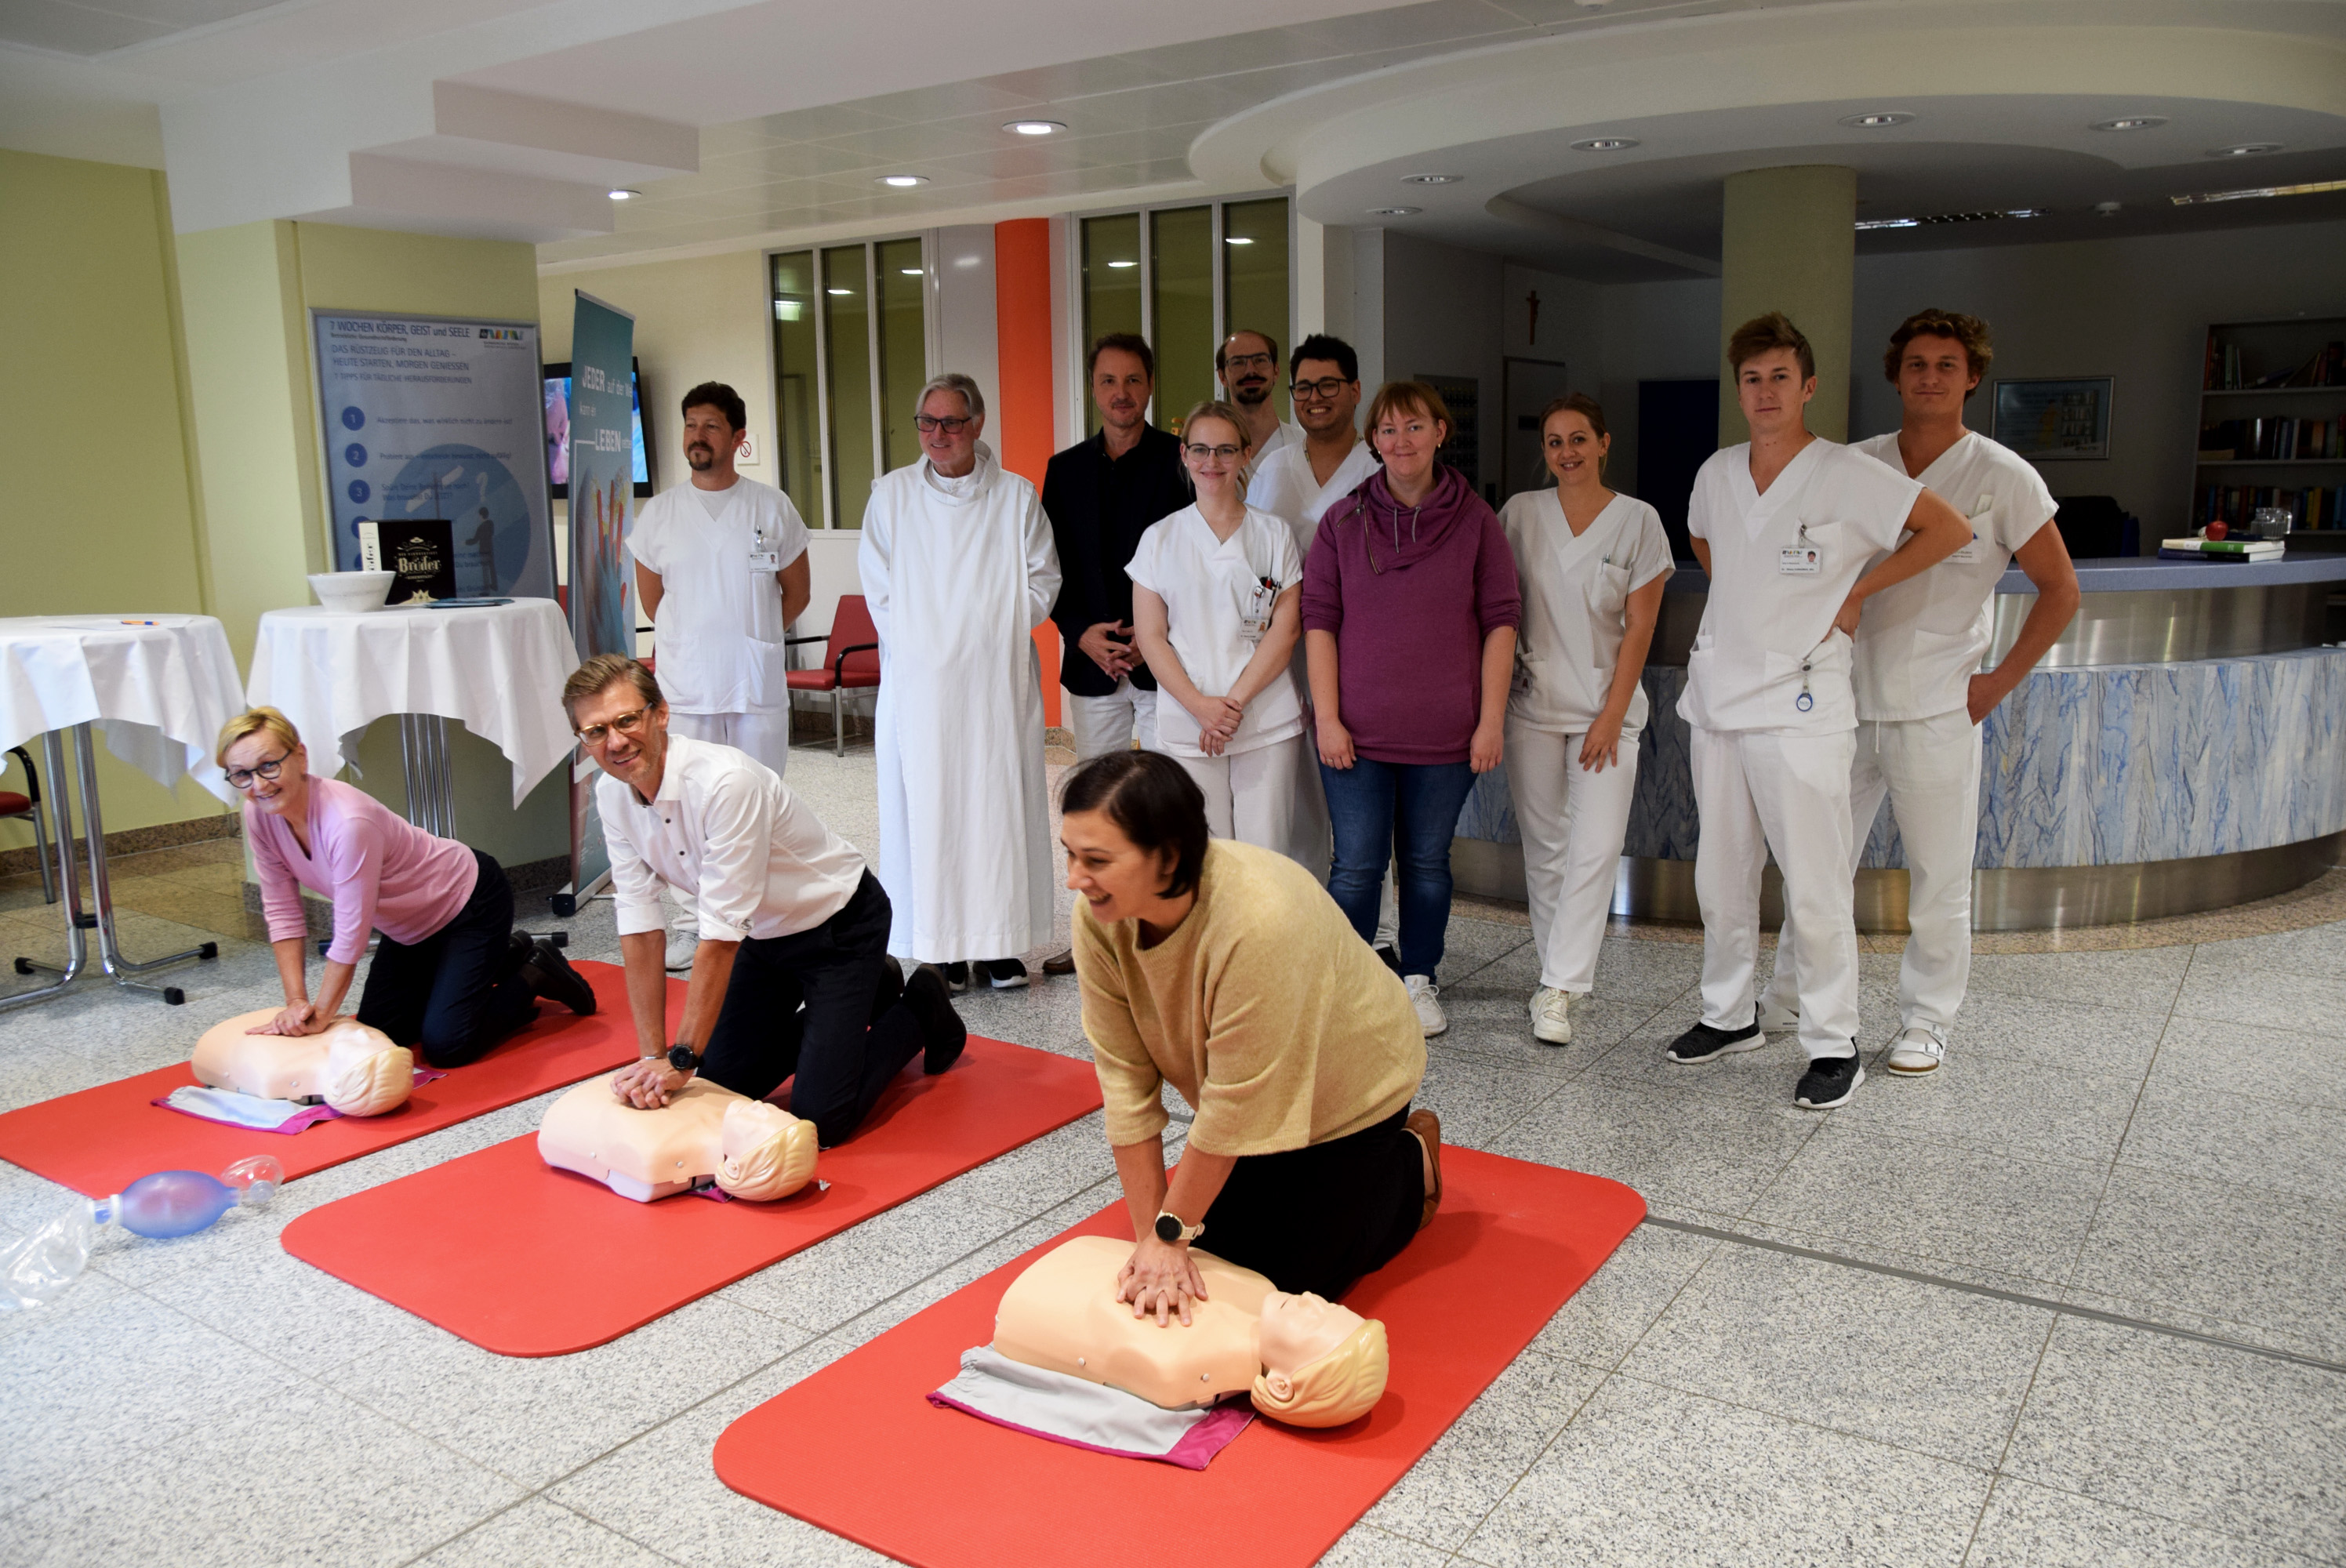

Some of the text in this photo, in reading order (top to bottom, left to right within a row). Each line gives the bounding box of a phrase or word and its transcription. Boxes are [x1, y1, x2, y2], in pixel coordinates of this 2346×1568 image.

[329, 321, 335, 330] 7
[338, 321, 374, 332] WOCHEN
[410, 325, 431, 336] GEIST
[433, 327, 447, 336] und
[448, 326, 470, 337] SEELE
[332, 344, 348, 354] DAS
[350, 345, 388, 355] RÜSTZEUG
[391, 347, 405, 356] FÜR
[408, 348, 422, 357] DEN
[425, 349, 450, 358] ALLTAG
[333, 358, 358, 367] HEUTE
[396, 360, 428, 368] MORGEN
[430, 361, 469, 371] GENIESSEN
[360, 372, 372, 381] FÜR
[405, 376, 472, 384] HERAUSFORDERUNGEN
[583, 366, 605, 391] JEDER
[607, 379, 616, 394] auf
[350, 414, 356, 423] 1
[595, 429, 621, 452] LEBEN
[353, 451, 359, 460] 2
[357, 488, 362, 497] 3
[398, 556, 441, 573] Brüder
